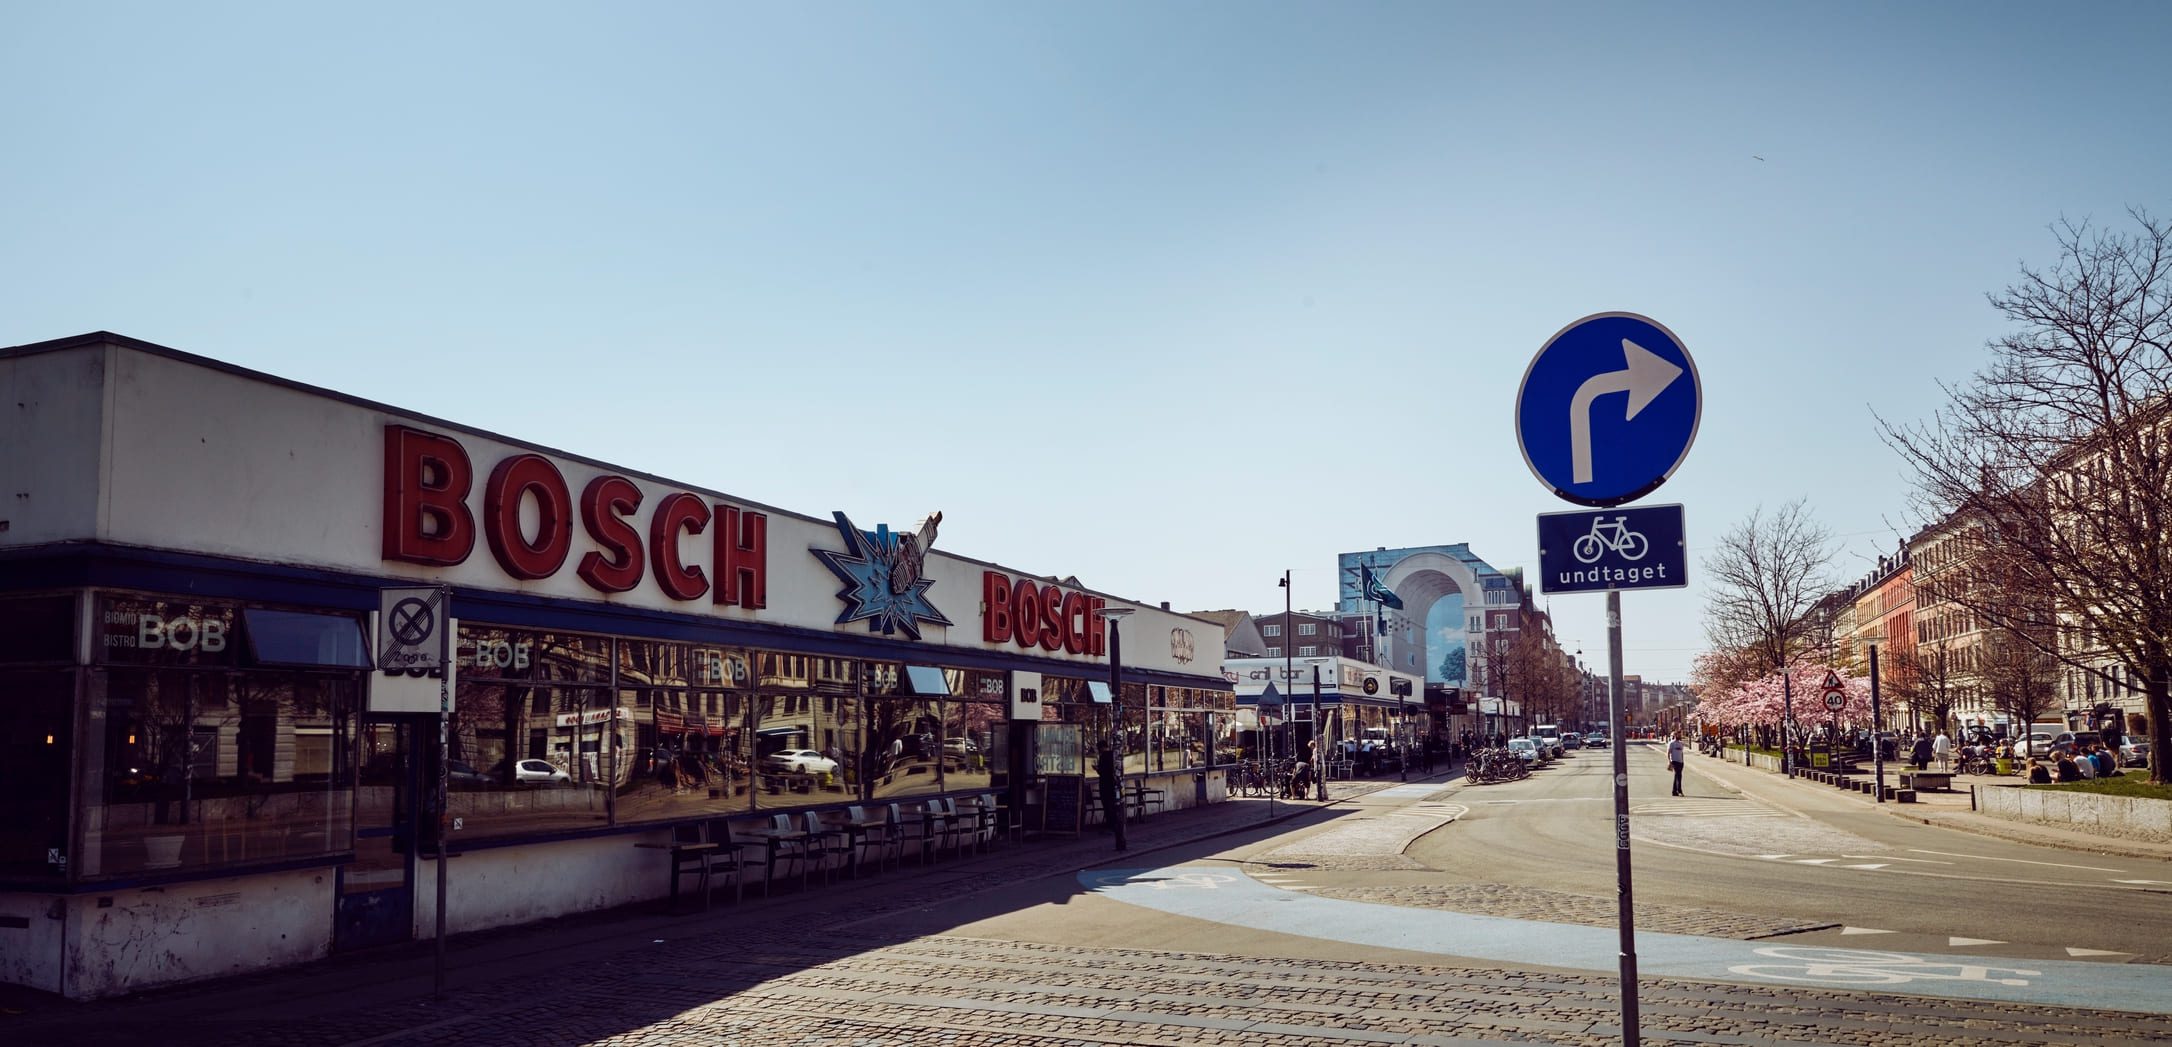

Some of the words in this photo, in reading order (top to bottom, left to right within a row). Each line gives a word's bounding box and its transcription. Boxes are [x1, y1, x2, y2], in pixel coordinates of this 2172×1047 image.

[382, 424, 767, 609] BOSCH
[1559, 562, 1666, 583] undtaget
[983, 571, 1105, 656] BOSCH
[103, 633, 136, 648] BISTRO
[138, 614, 227, 652] BOB
[475, 639, 530, 669] BOB
[711, 657, 746, 681] BOB
[874, 668, 898, 689] BOB
[986, 678, 1004, 694] BOB
[1020, 688, 1036, 703] BOB
[1826, 695, 1843, 706] 40
